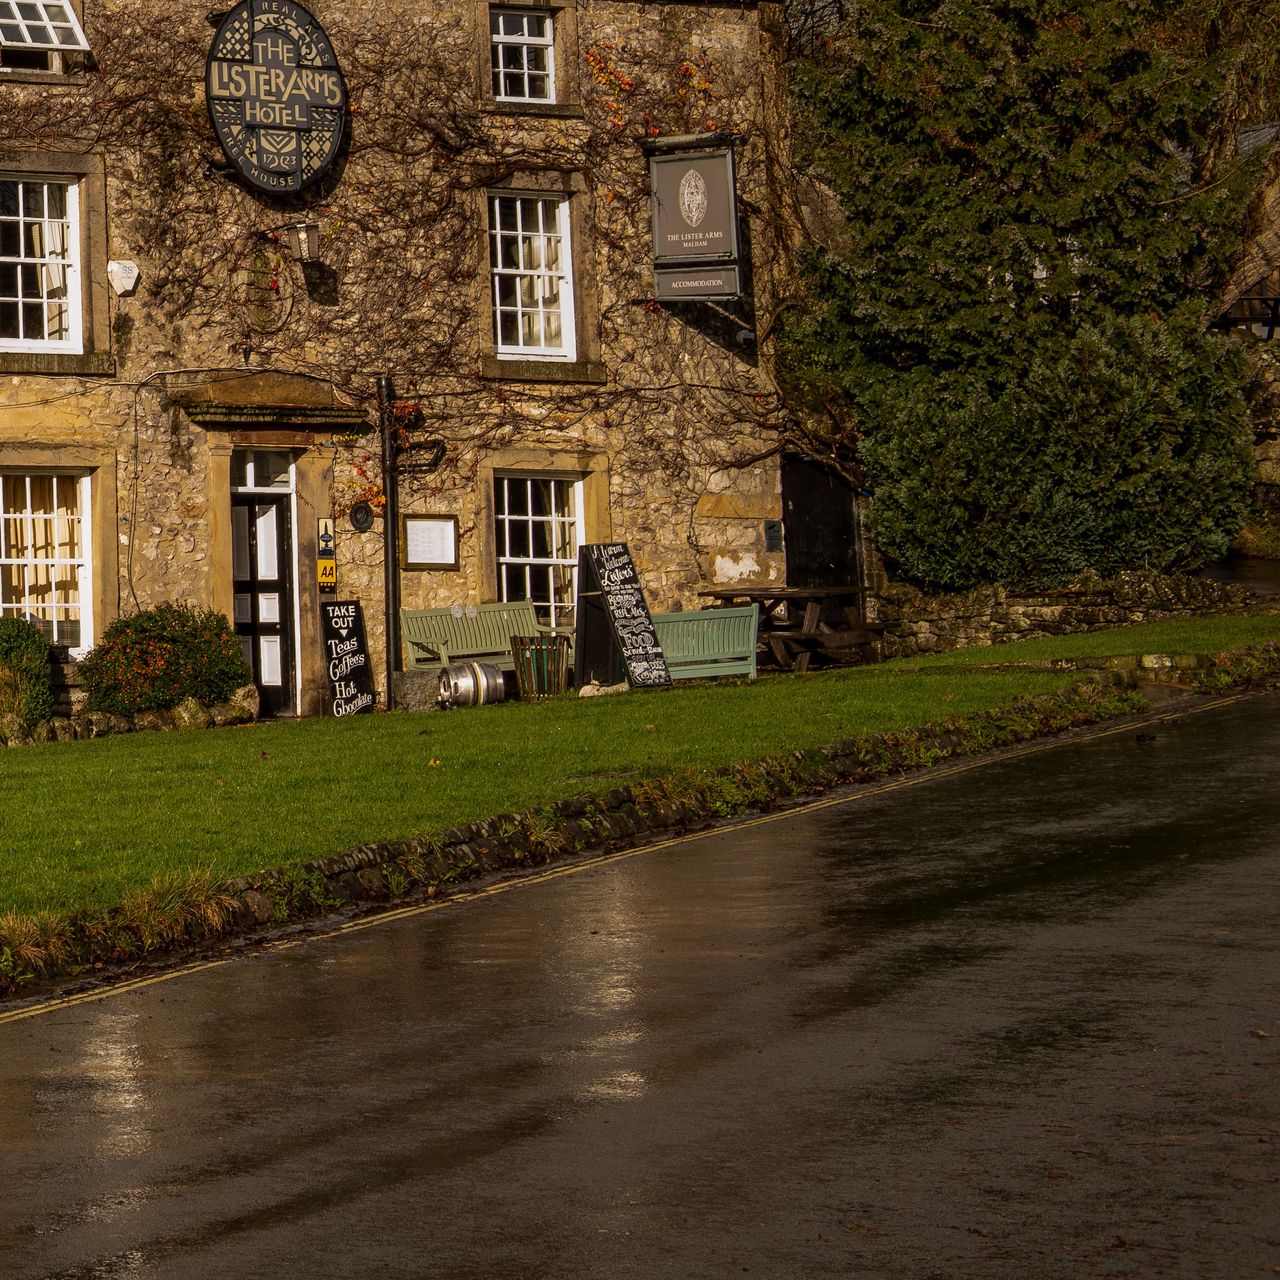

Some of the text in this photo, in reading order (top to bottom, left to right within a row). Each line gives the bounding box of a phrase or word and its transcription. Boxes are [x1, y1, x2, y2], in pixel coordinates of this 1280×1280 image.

[261, 1, 330, 62] REAL ALES
[253, 38, 297, 67] THE
[211, 61, 341, 105] LISTER ARMS
[245, 100, 308, 127] HOTEL
[222, 127, 295, 187] FREE HOUSE
[681, 232, 704, 241] LISTER
[704, 231, 724, 239] ARMS
[683, 240, 708, 248] MALHAM
[671, 279, 723, 288] ACCOMMODATION
[320, 566, 334, 578] AA
[326, 605, 356, 618] TAKE
[331, 617, 354, 628] OUT
[328, 637, 358, 658] Teas
[624, 632, 655, 648] FOOD
[334, 681, 357, 699] Hot
[333, 692, 373, 718] Chocolate
